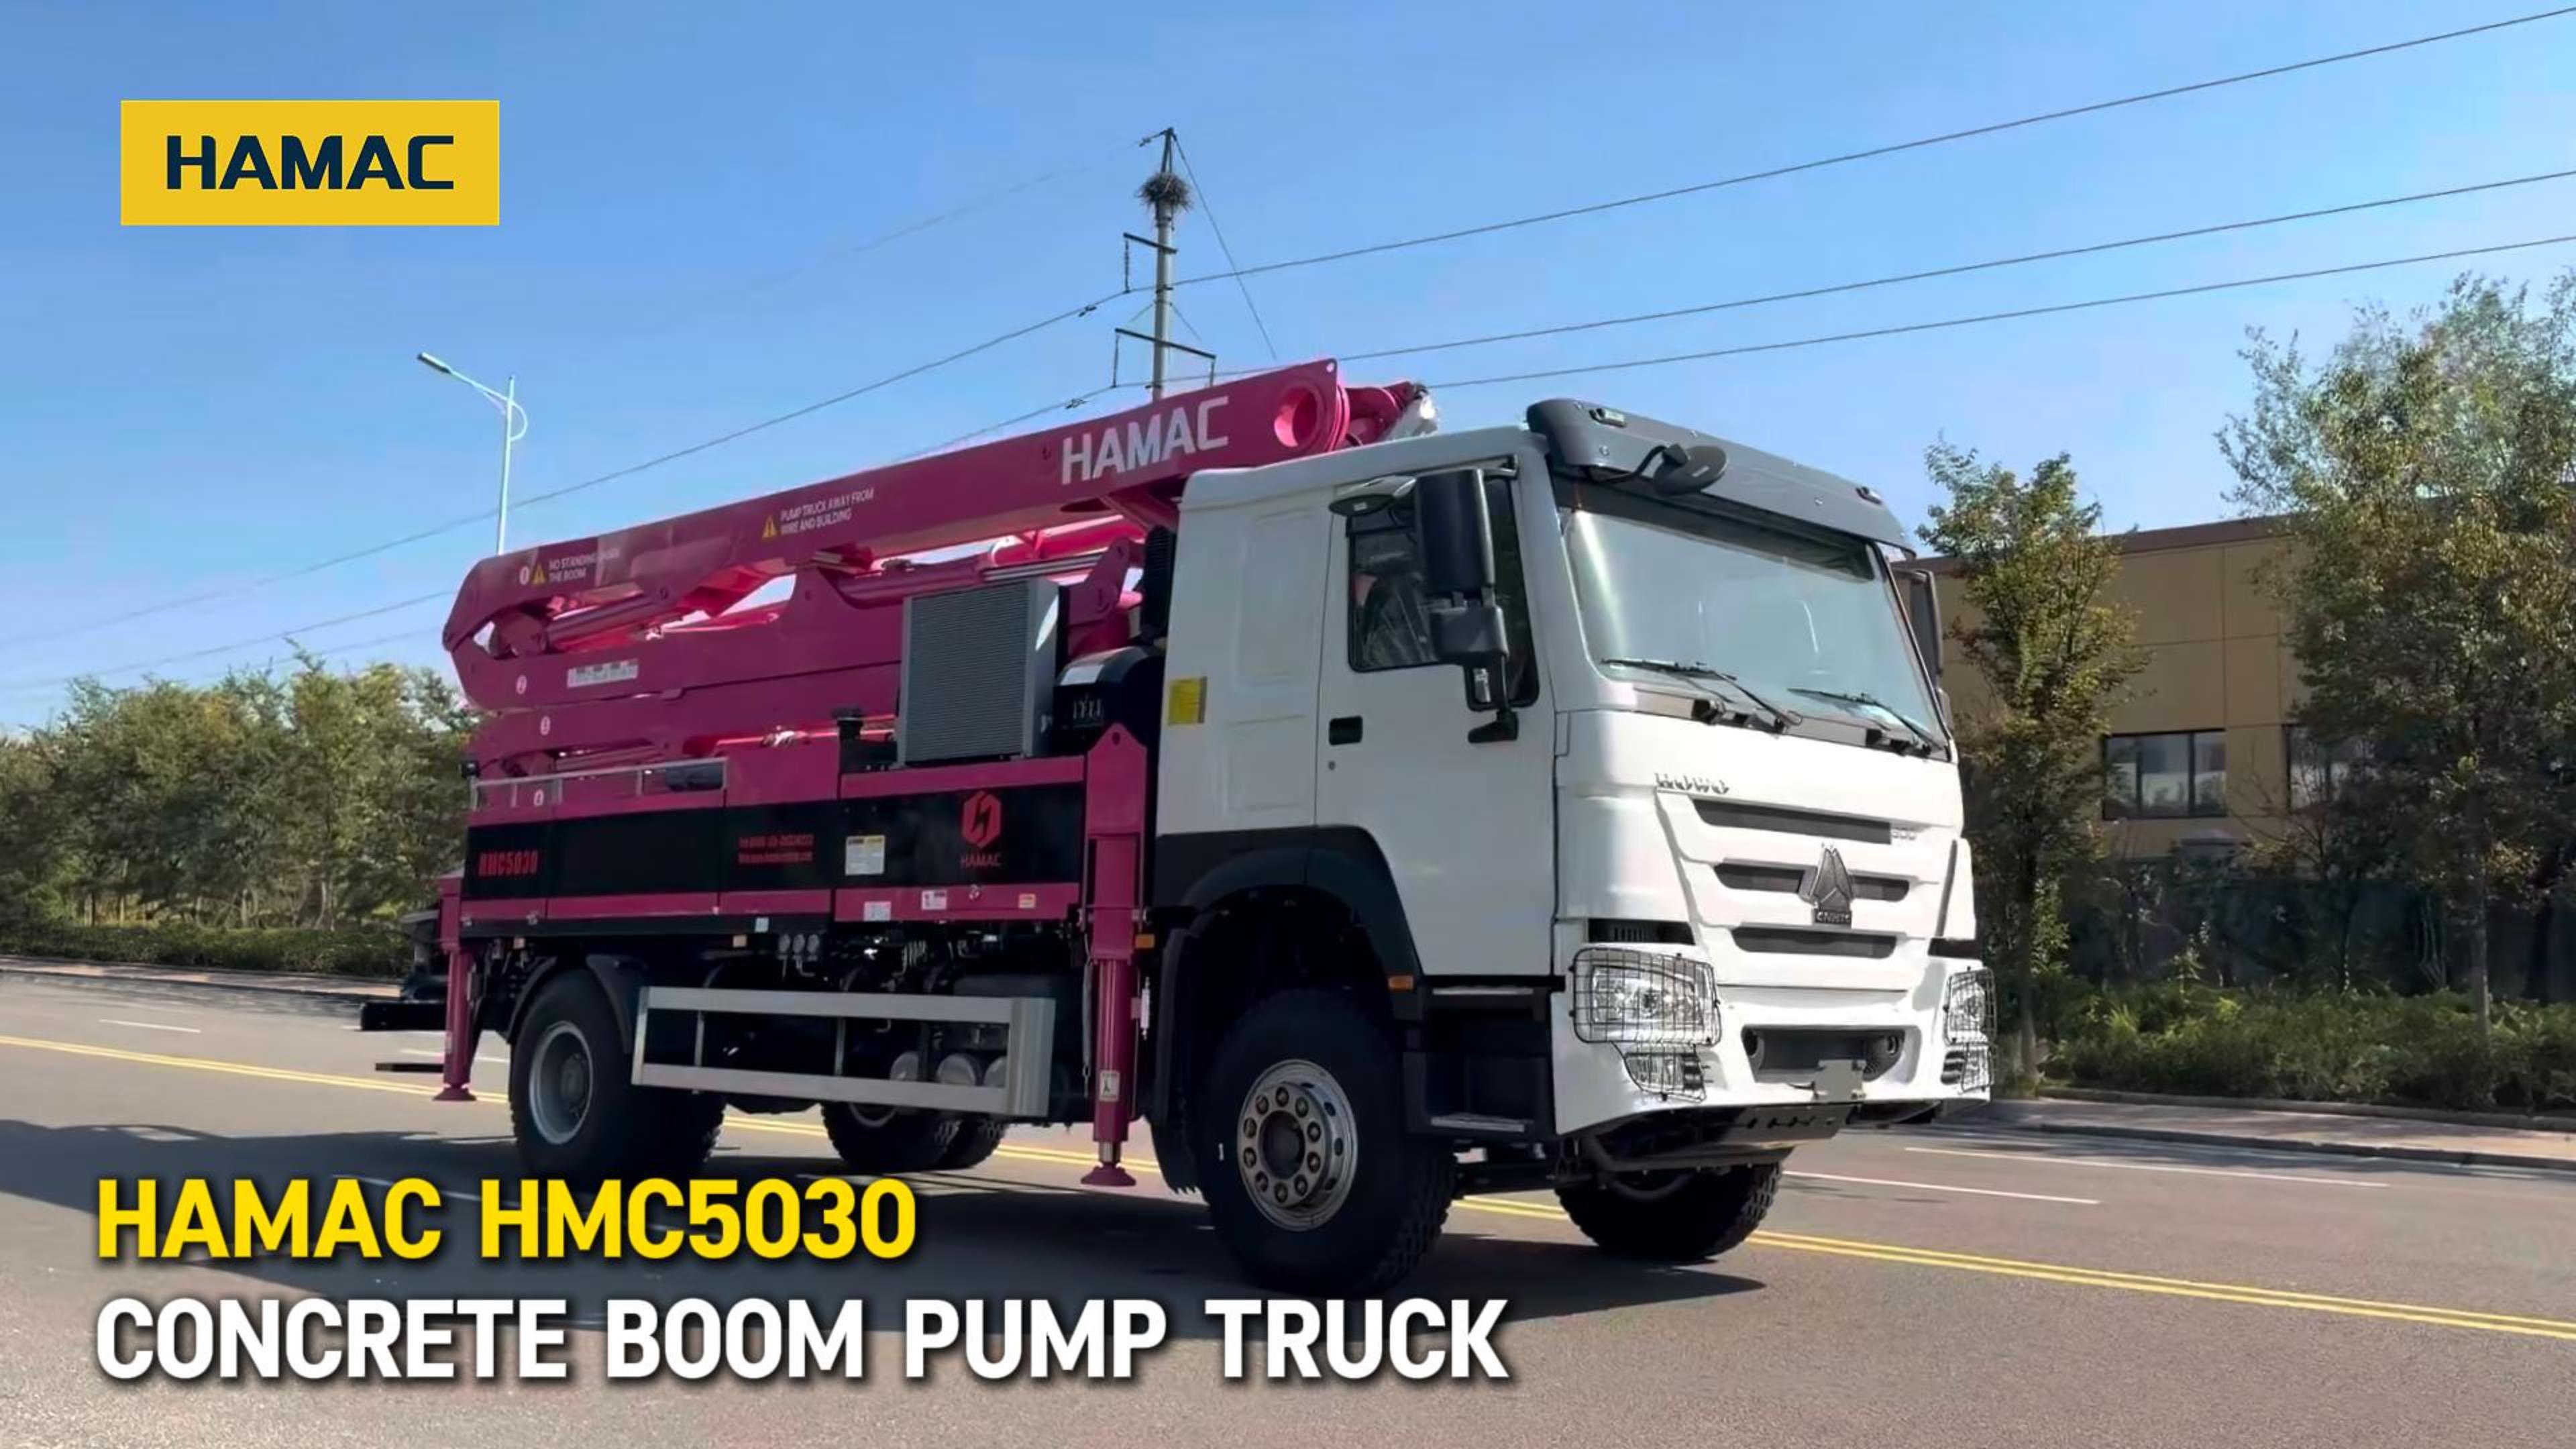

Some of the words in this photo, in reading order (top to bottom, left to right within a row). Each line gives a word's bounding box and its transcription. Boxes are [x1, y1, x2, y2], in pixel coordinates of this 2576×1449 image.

[1062, 396, 1229, 484] HAMAC
[851, 487, 874, 503] FROM
[799, 517, 816, 531] AND
[816, 508, 852, 529] BUILDING
[478, 849, 539, 877] HMC5030
[960, 853, 1002, 869] HAMAC
